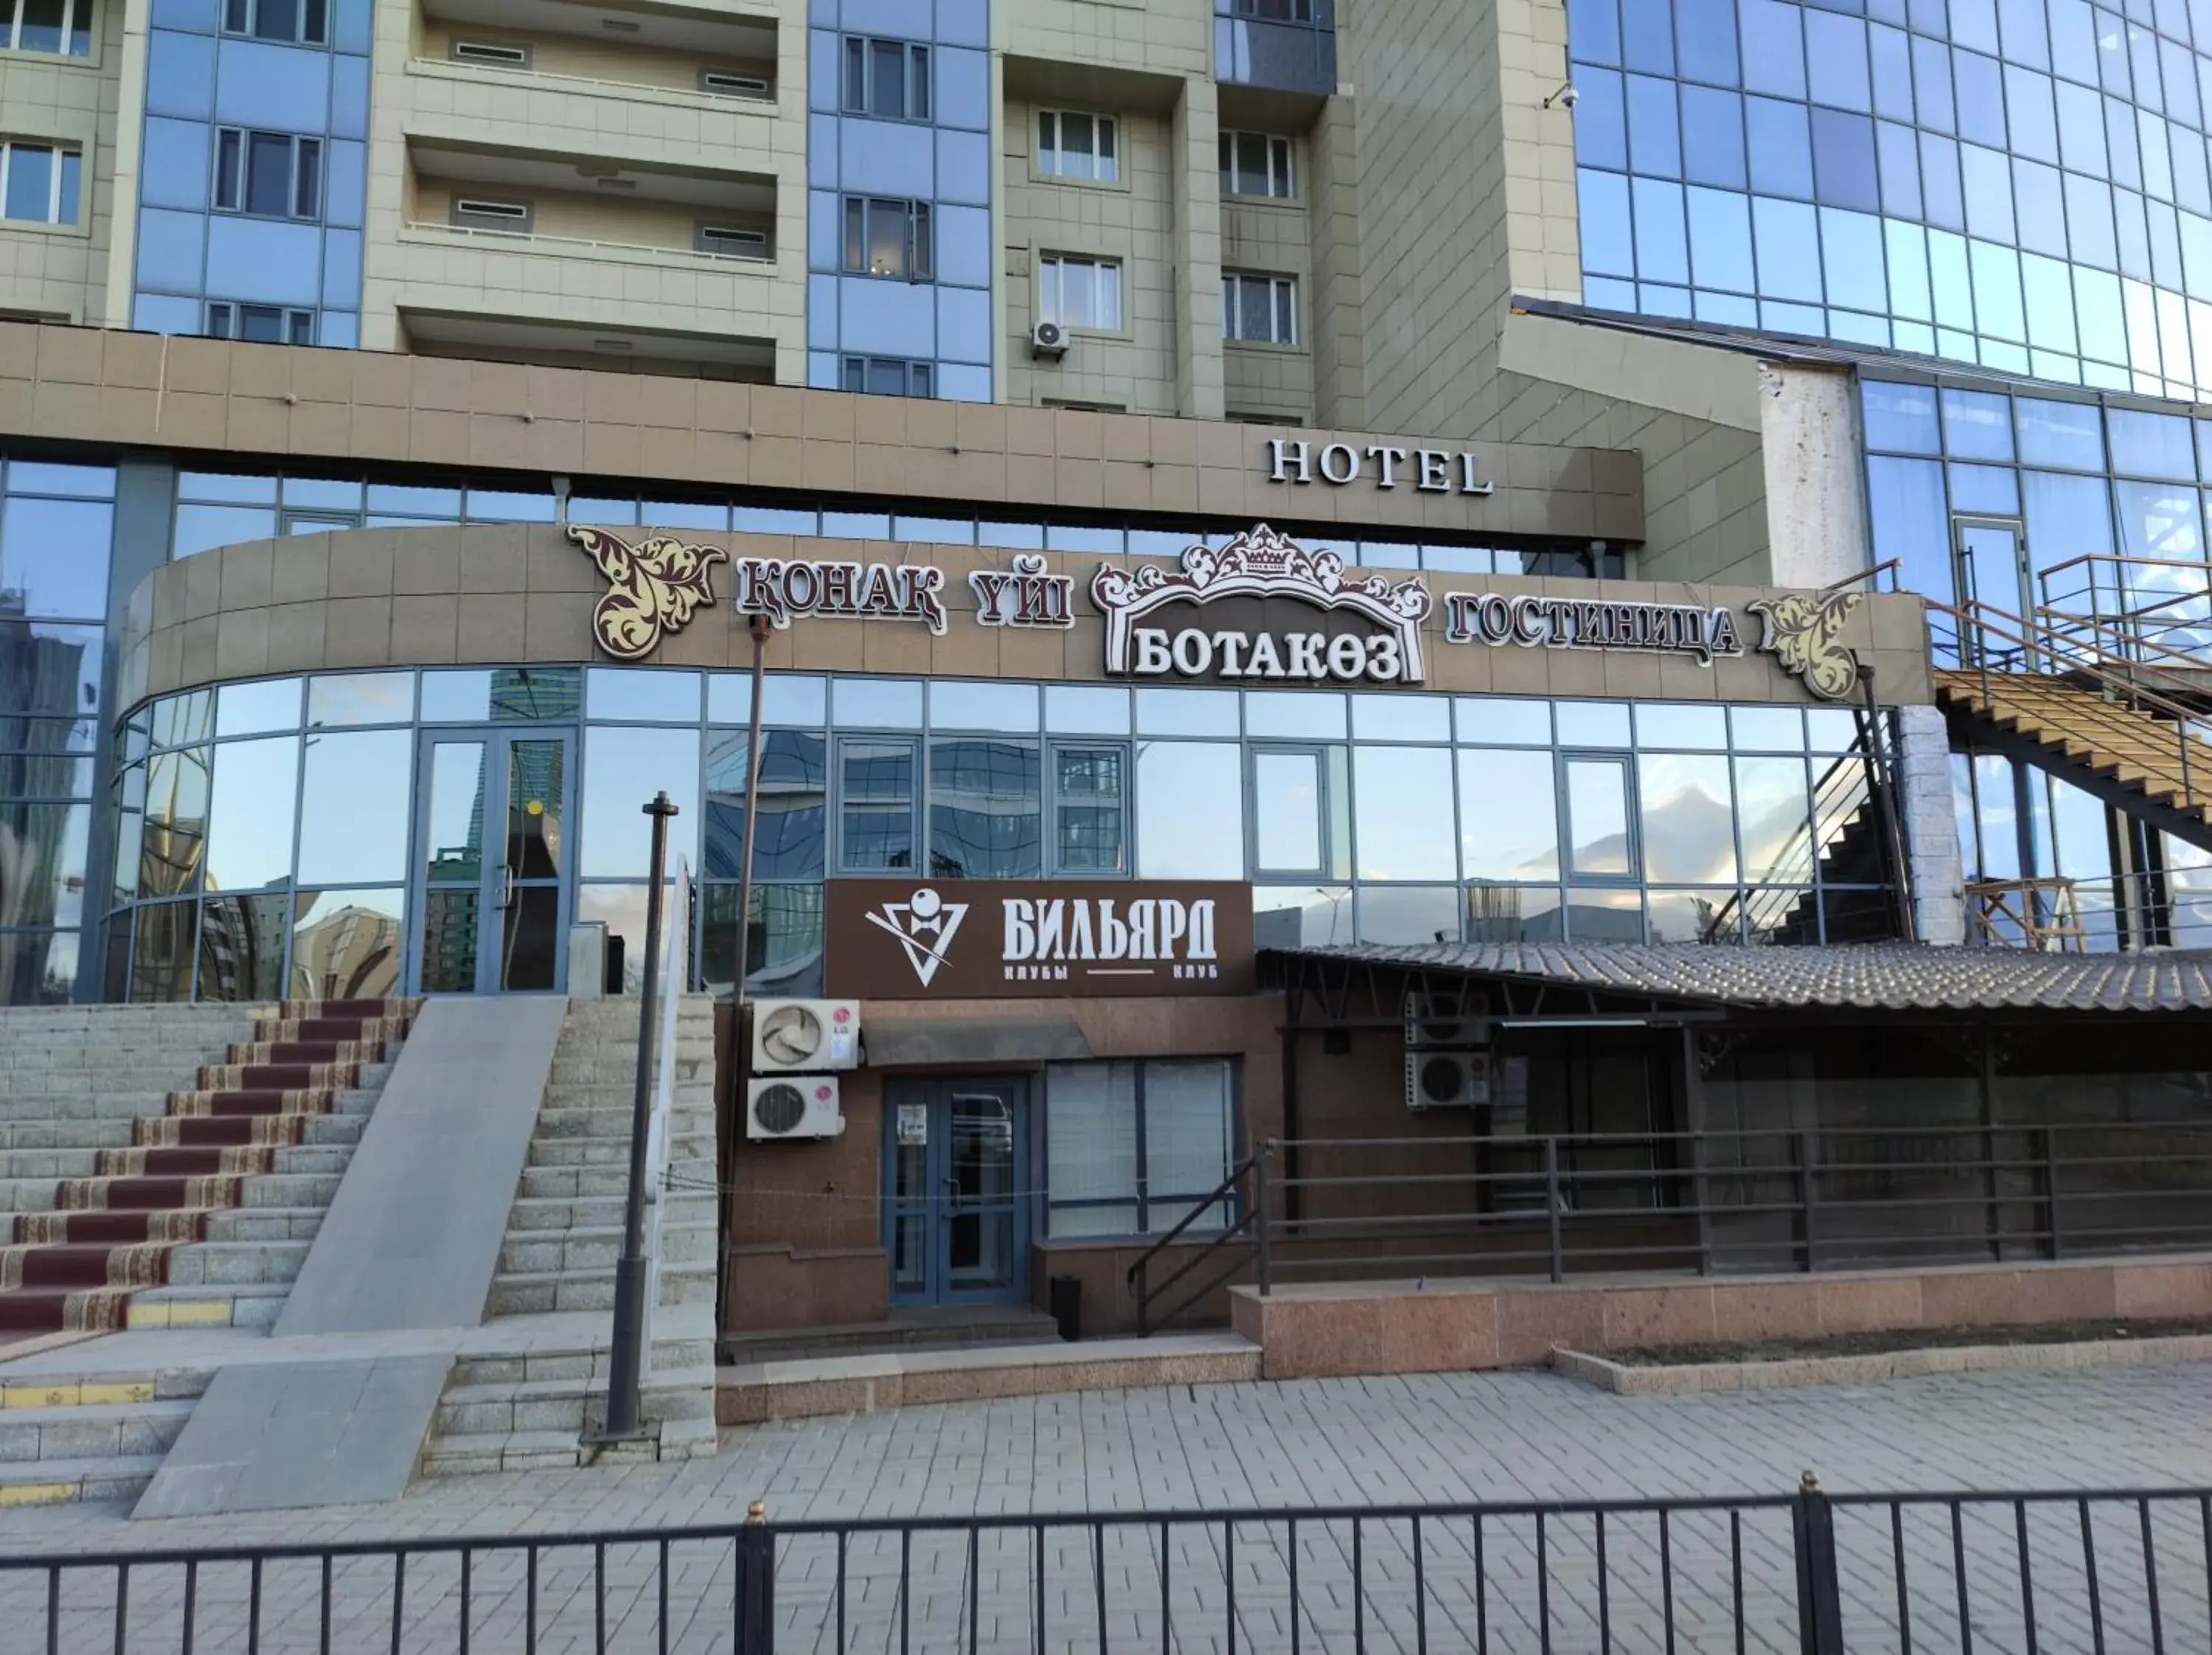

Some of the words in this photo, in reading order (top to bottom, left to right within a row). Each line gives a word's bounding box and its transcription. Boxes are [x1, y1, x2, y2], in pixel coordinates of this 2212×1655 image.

[1268, 438, 1494, 496] HOTEL
[740, 558, 946, 633] ҚОНАҚ
[973, 556, 1074, 627] ҮЙІ
[1133, 627, 1401, 681] БОТАКӨЗ
[1447, 593, 1744, 667] ГОСТИНИЦА
[1002, 899, 1217, 960] БИЛЬЯРД
[1004, 965, 1069, 980] КЛУБЫ
[1172, 964, 1218, 979] КЛУБ
